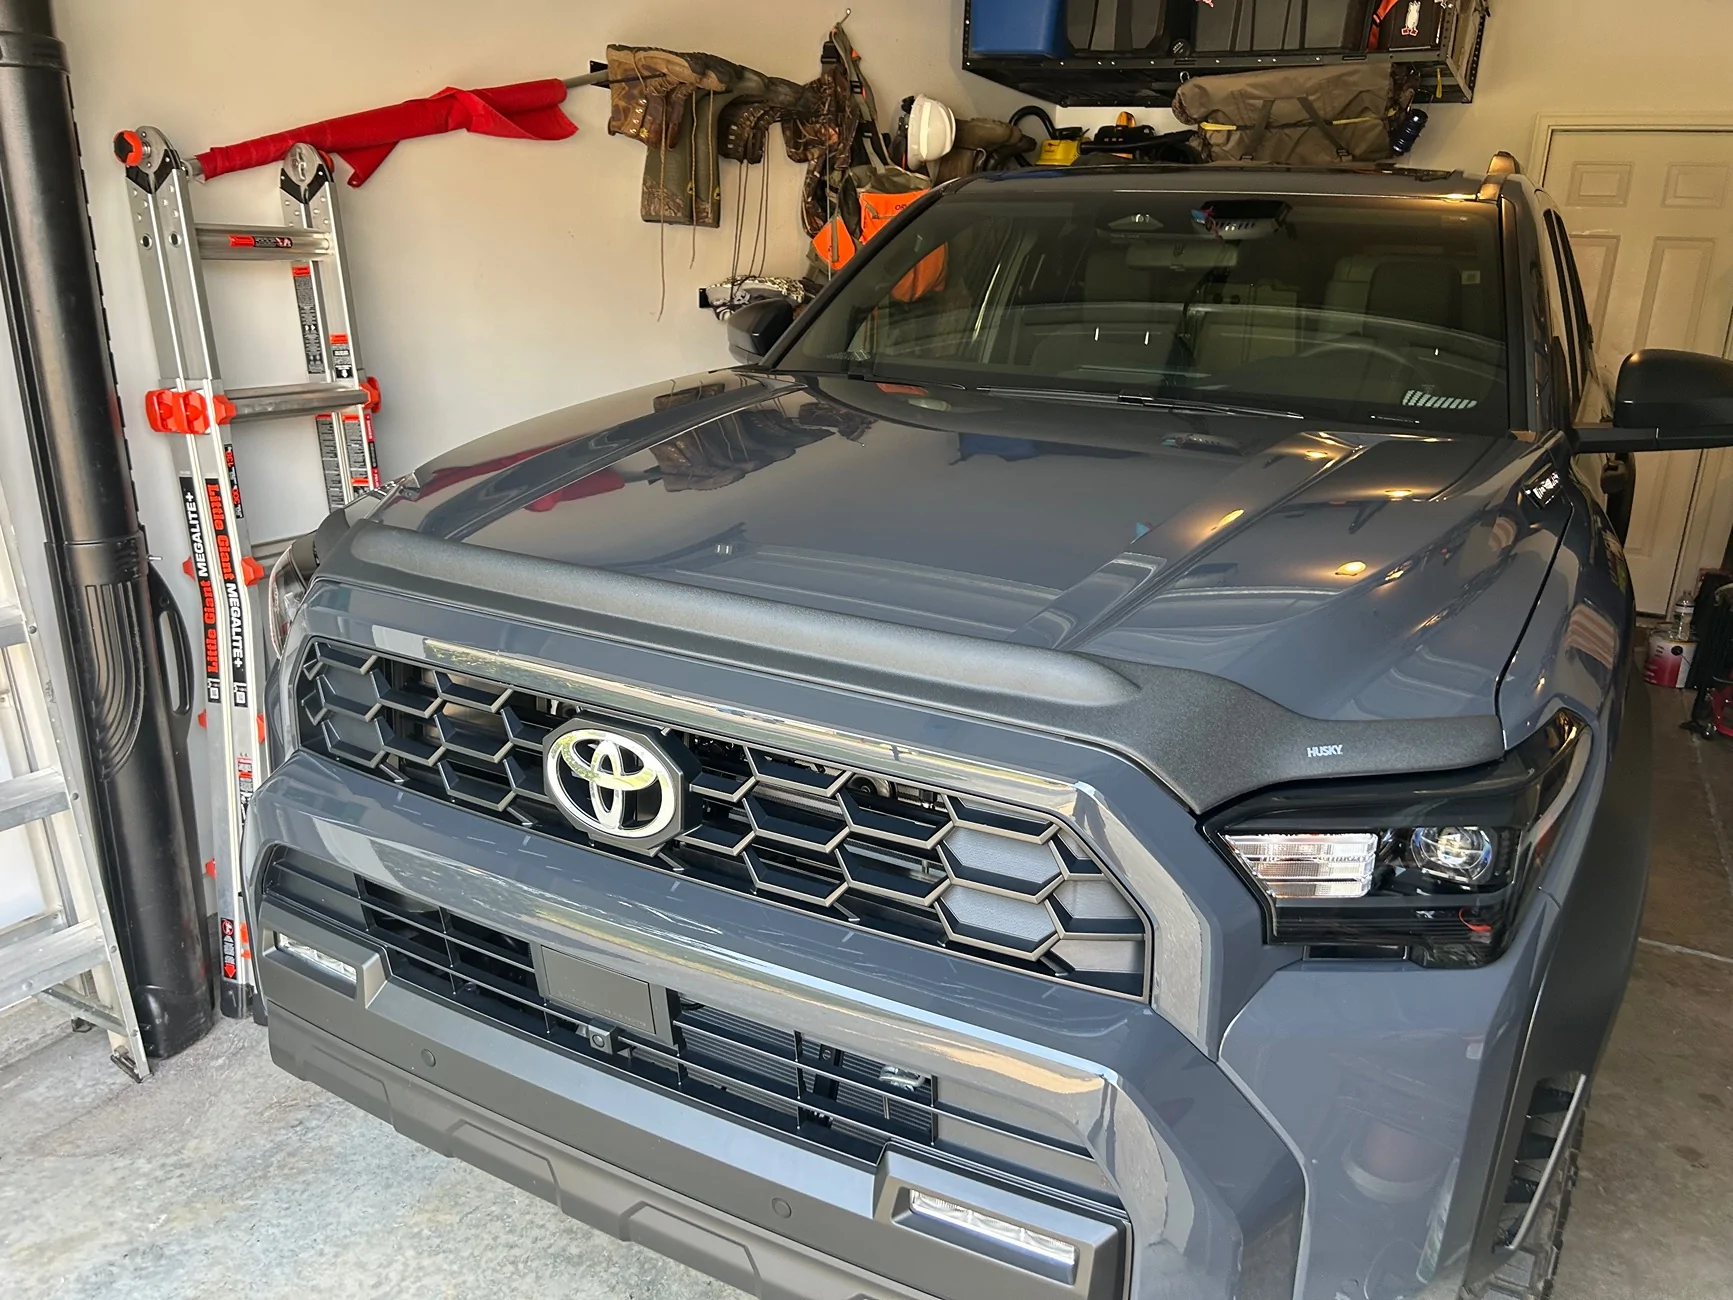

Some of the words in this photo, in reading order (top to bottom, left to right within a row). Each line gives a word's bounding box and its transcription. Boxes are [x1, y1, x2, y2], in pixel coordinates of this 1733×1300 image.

[185, 491, 209, 577] MEGALITE+
[207, 484, 225, 530] Little
[217, 534, 235, 580] Giant
[226, 582, 244, 668] MEGALITE+
[200, 580, 216, 624] Giant
[206, 628, 219, 673] Little
[1306, 744, 1343, 758] HUSKY
